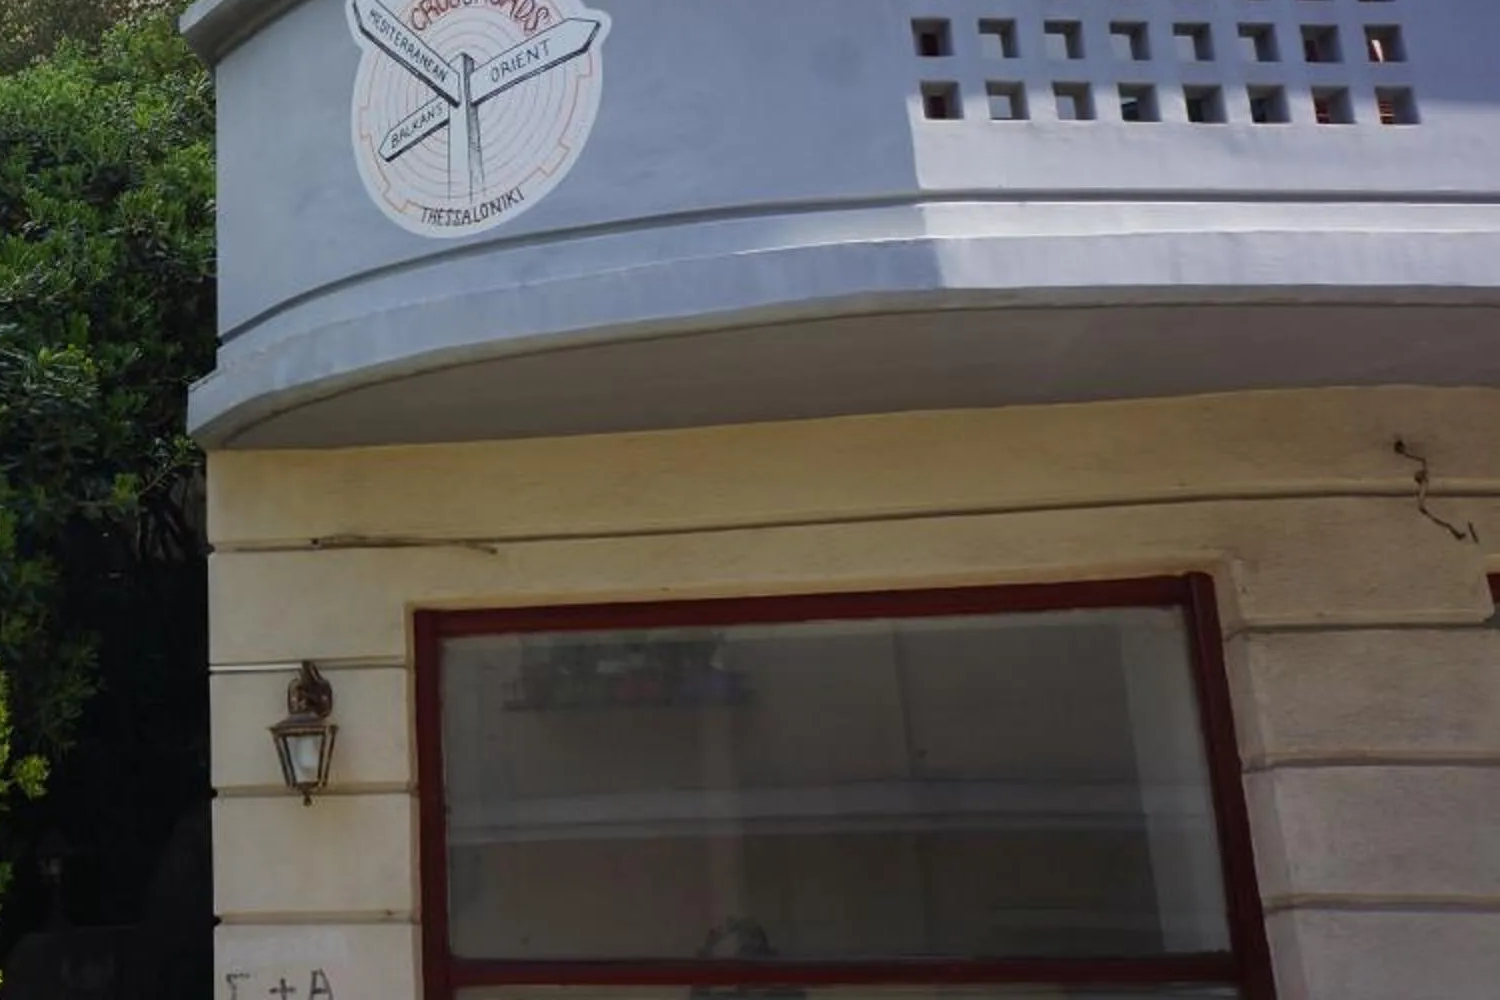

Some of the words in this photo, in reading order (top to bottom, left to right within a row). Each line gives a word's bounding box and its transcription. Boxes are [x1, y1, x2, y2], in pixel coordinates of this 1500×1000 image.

[489, 38, 551, 83] ORIENT
[391, 101, 444, 149] BALKANS
[420, 185, 526, 227] THESSALONIKI
